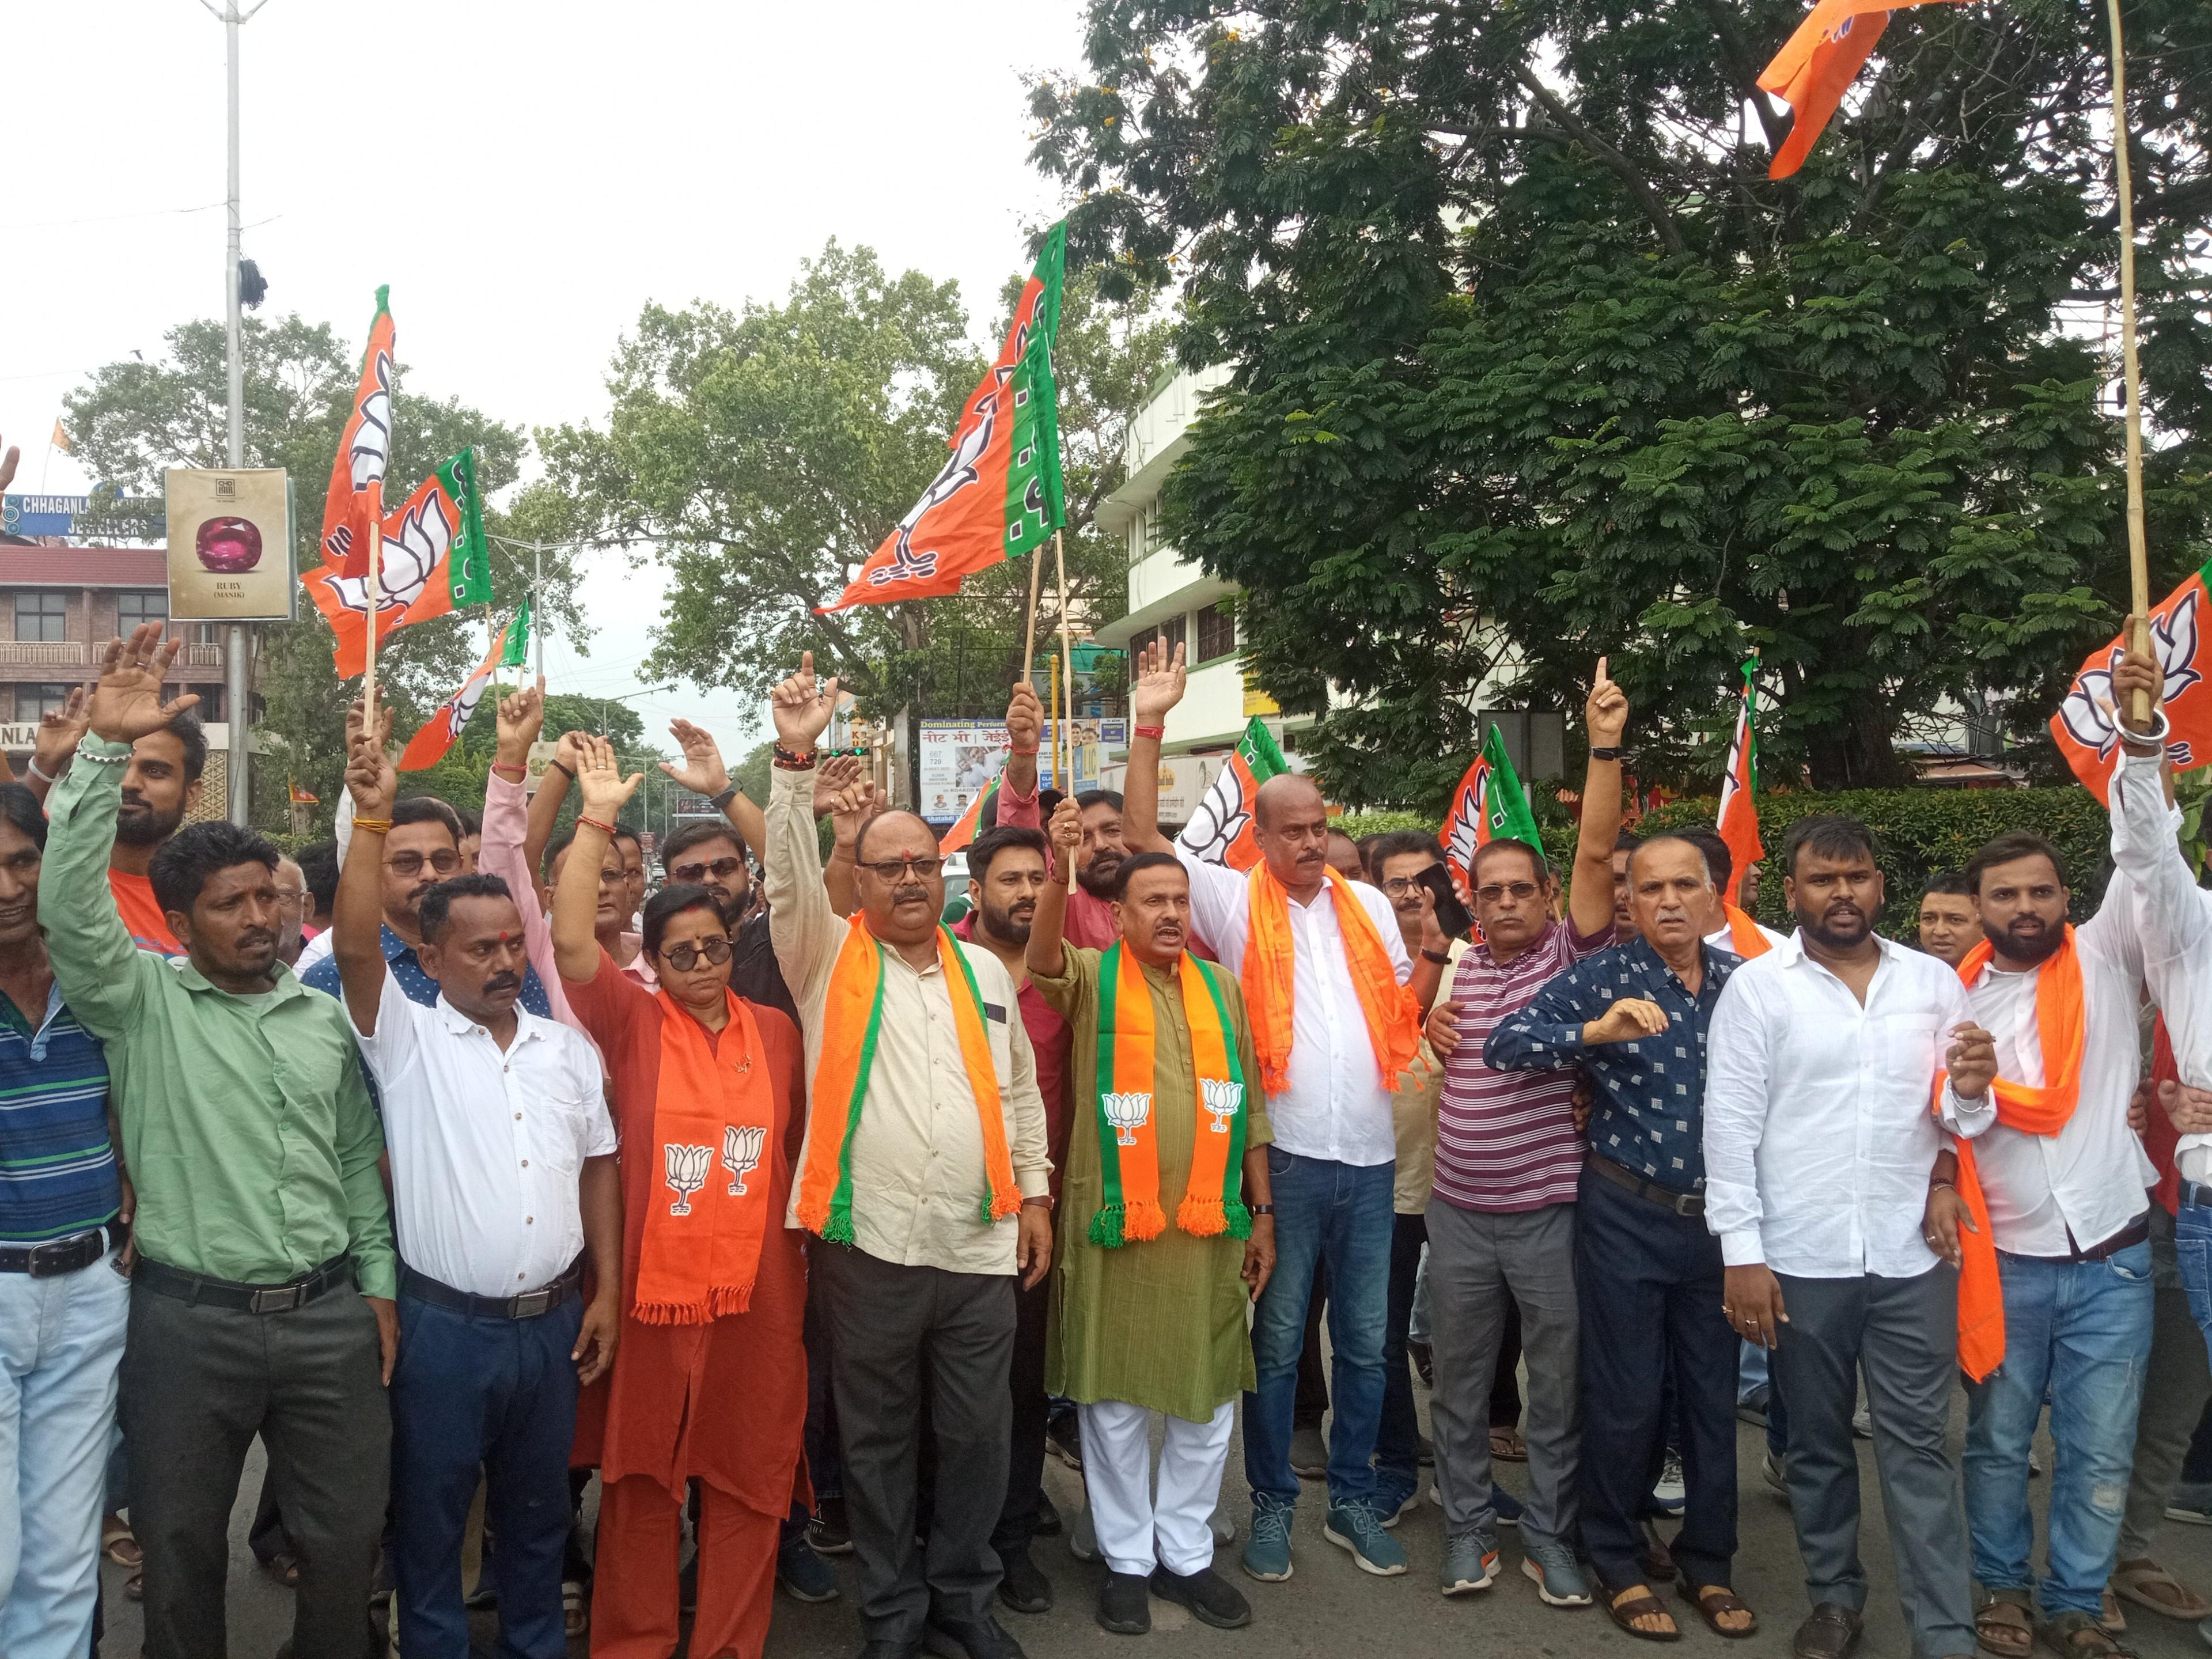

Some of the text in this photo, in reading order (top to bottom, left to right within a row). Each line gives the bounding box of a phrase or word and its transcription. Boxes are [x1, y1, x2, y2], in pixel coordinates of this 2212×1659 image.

[23, 497, 92, 514] CHHAGANLA
[922, 731, 949, 743] नीट
[953, 731, 971, 743] भी
[1084, 748, 1096, 775] LIC
